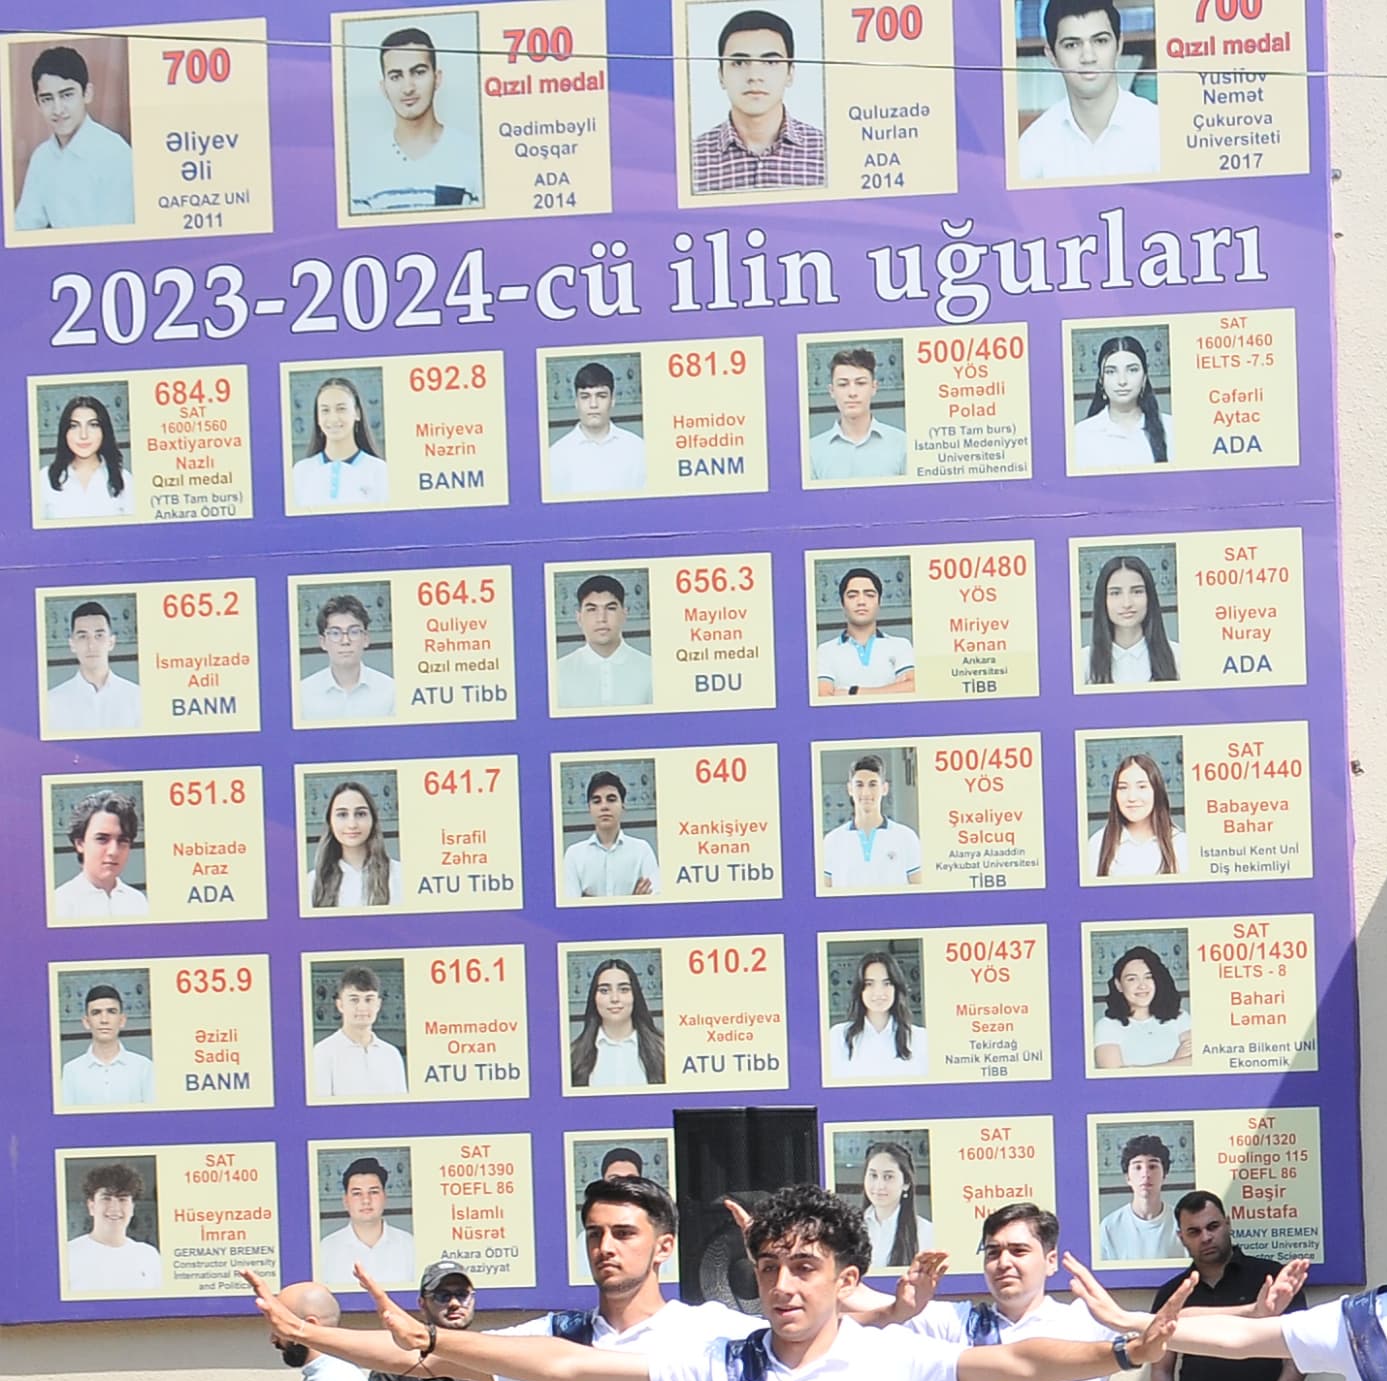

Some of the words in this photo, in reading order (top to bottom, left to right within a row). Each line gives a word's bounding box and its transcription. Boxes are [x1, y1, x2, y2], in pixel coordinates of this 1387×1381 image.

[851, 4, 923, 44] 700
[162, 47, 231, 86] 700
[1203, 87, 1264, 105] Nemət
[848, 102, 931, 121] Quluzadə
[1192, 113, 1273, 132] Çukurova
[861, 124, 919, 141] Nurlan
[1186, 129, 1281, 149] Universiteti
[165, 130, 239, 156] Əliyev
[864, 152, 901, 168] ADA
[1219, 152, 1264, 171] 2017
[181, 159, 212, 182] Əli
[860, 172, 905, 190] 2014
[158, 192, 221, 209] QAFQAZ
[224, 189, 250, 205] UNİ
[183, 212, 223, 230] 2011
[50, 241, 640, 347] 2023-2024-cü
[669, 229, 840, 314] ilin
[868, 208, 1268, 324] uğurları
[1220, 316, 1248, 330] SAT
[917, 335, 1024, 364] 500/460
[1196, 333, 1273, 350] 1600/1460
[1196, 353, 1241, 370] İELTS
[1246, 352, 1275, 367] -7.5
[409, 364, 487, 393] 692.8
[952, 362, 989, 380] YÖS
[154, 378, 231, 406] 684.9
[938, 381, 1006, 399] Səmədli
[1208, 387, 1264, 405] Cəfərli
[179, 405, 207, 419] SAT
[948, 401, 996, 419] Polad
[1212, 410, 1261, 428] Aytac
[161, 419, 228, 434] 1600/1560
[415, 422, 484, 440] Miriyeva
[147, 436, 242, 454] Bəxtiyarova
[424, 443, 476, 457] Nəzrin
[1212, 434, 1263, 455] ADA
[175, 455, 215, 470] Nazlı
[419, 469, 484, 491] BANM
[675, 565, 755, 594] 656.3
[684, 606, 748, 625] Mayılov
[690, 627, 743, 642] Kənan
[675, 647, 709, 662] Qızıl
[713, 645, 759, 661] medal
[695, 672, 742, 693] BDU
[1227, 741, 1265, 759] SAT
[1191, 759, 1303, 782] 1600/1440
[1206, 799, 1289, 816] Babayeva
[1223, 818, 1274, 834] Bahar
[205, 1153, 236, 1168] SAT
[1218, 1151, 1281, 1165] Duolingo
[1285, 1149, 1309, 1162] 115
[184, 1168, 258, 1184] 1600/1400
[1229, 1168, 1277, 1181] TOEFL
[1281, 1167, 1297, 1179] 86
[1242, 1184, 1287, 1202] Bəşir
[174, 1206, 272, 1225] Hüseynzadə
[200, 1224, 247, 1241] İmran
